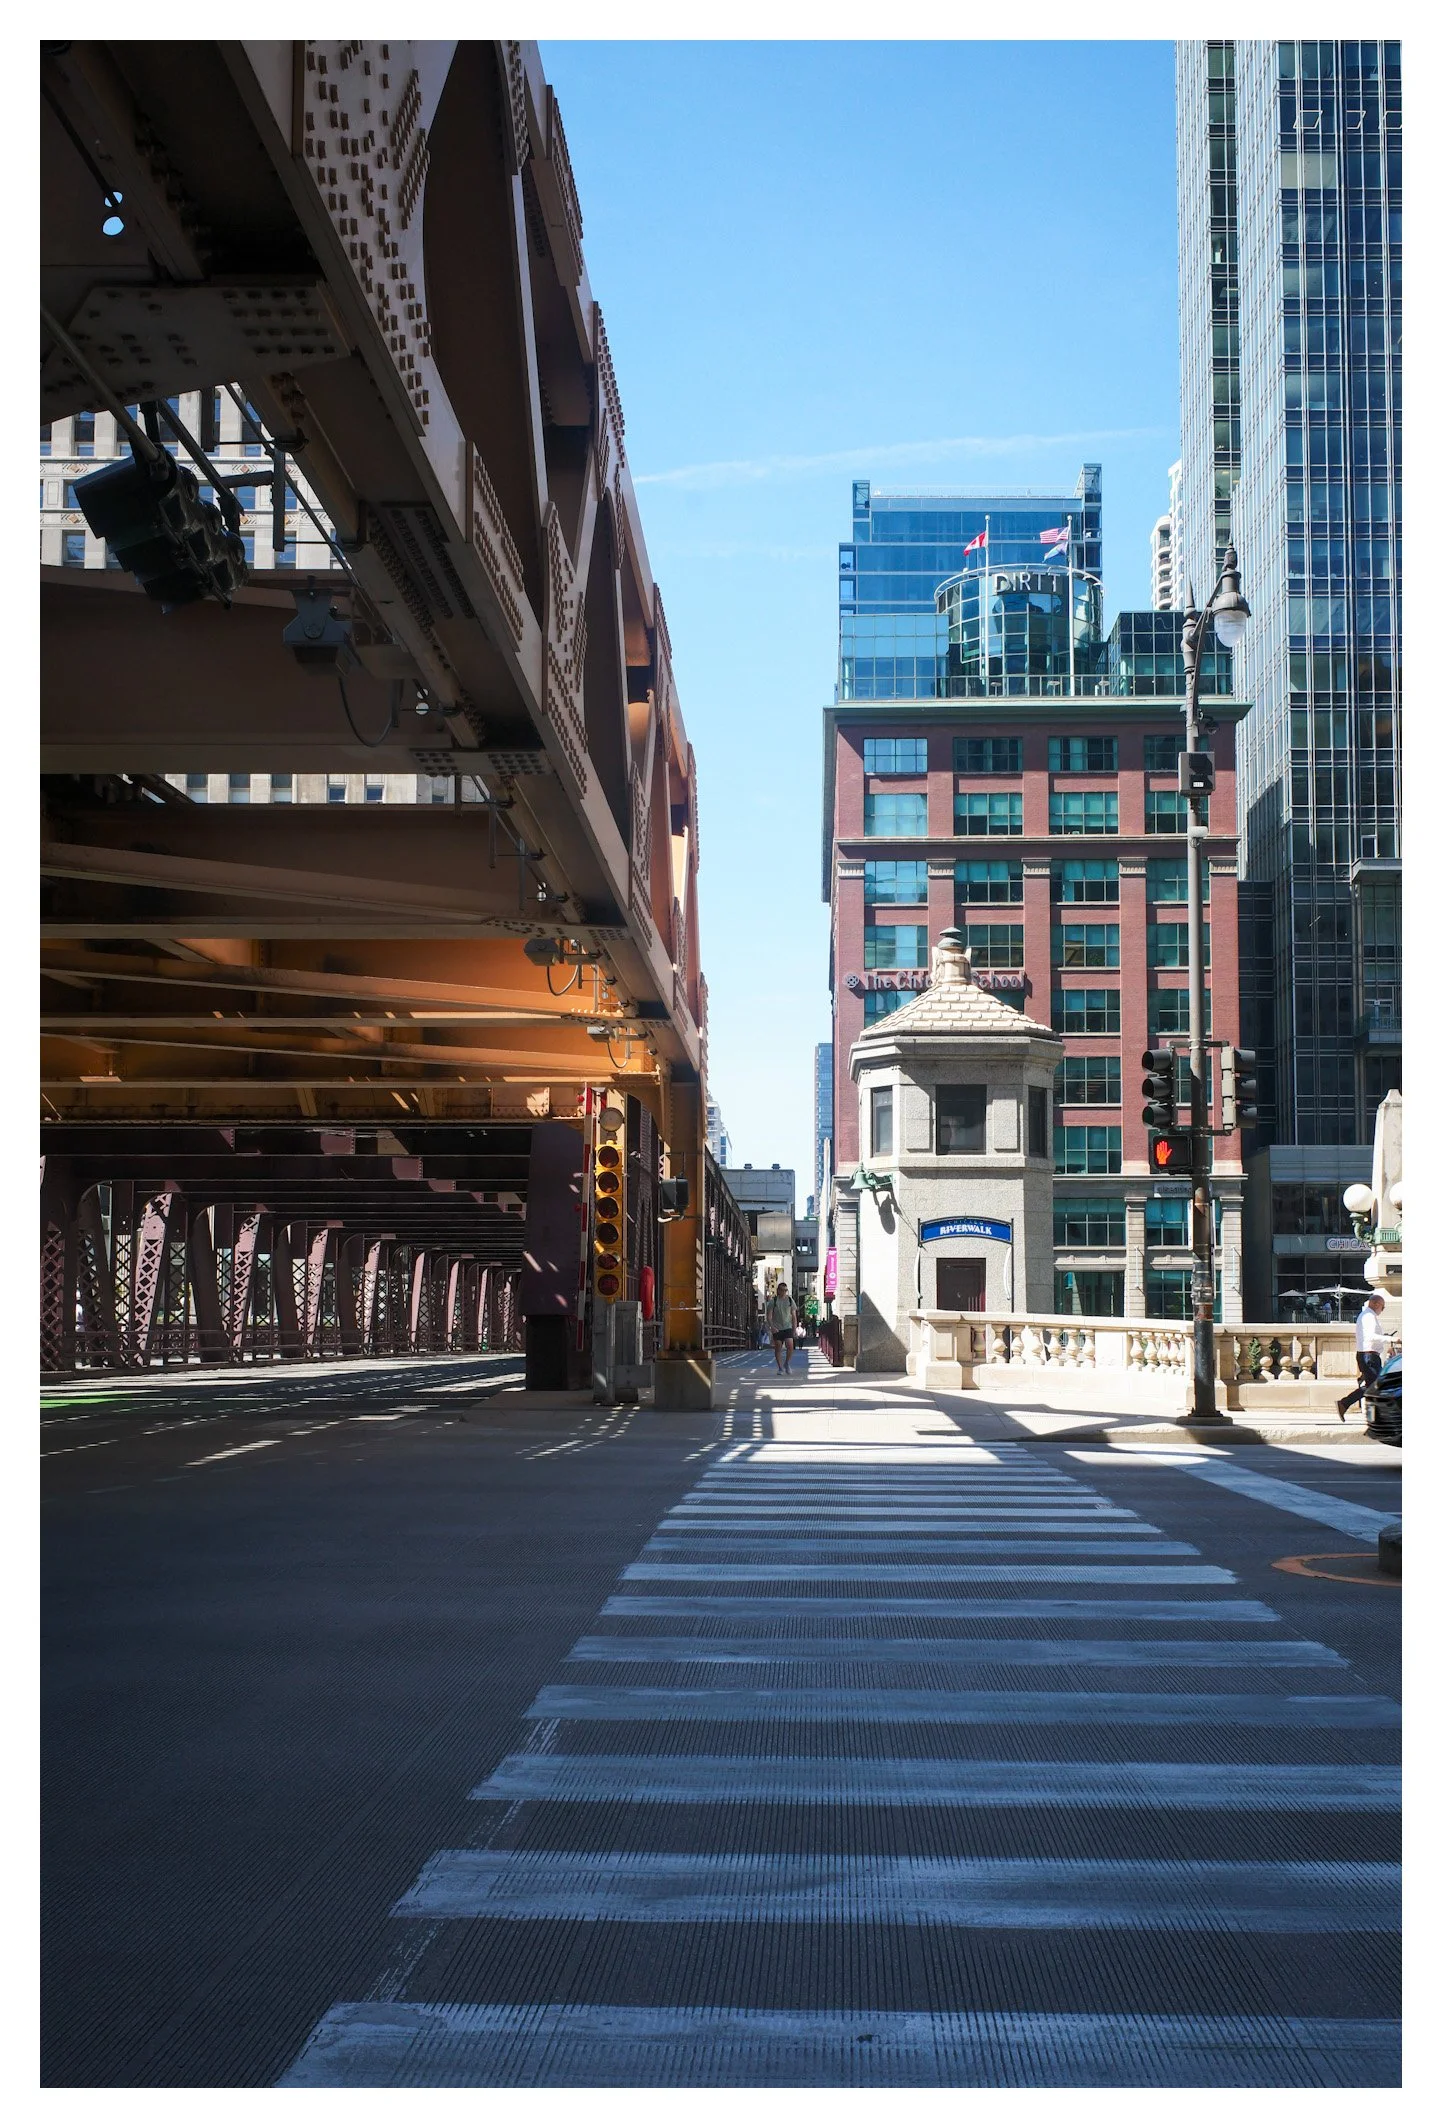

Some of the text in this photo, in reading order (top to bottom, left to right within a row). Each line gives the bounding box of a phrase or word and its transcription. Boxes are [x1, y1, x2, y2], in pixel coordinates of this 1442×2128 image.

[994, 571, 1061, 593] DIRTT
[864, 971, 892, 989] The
[971, 971, 1025, 989] School
[940, 1224, 993, 1236] RIVERWALK
